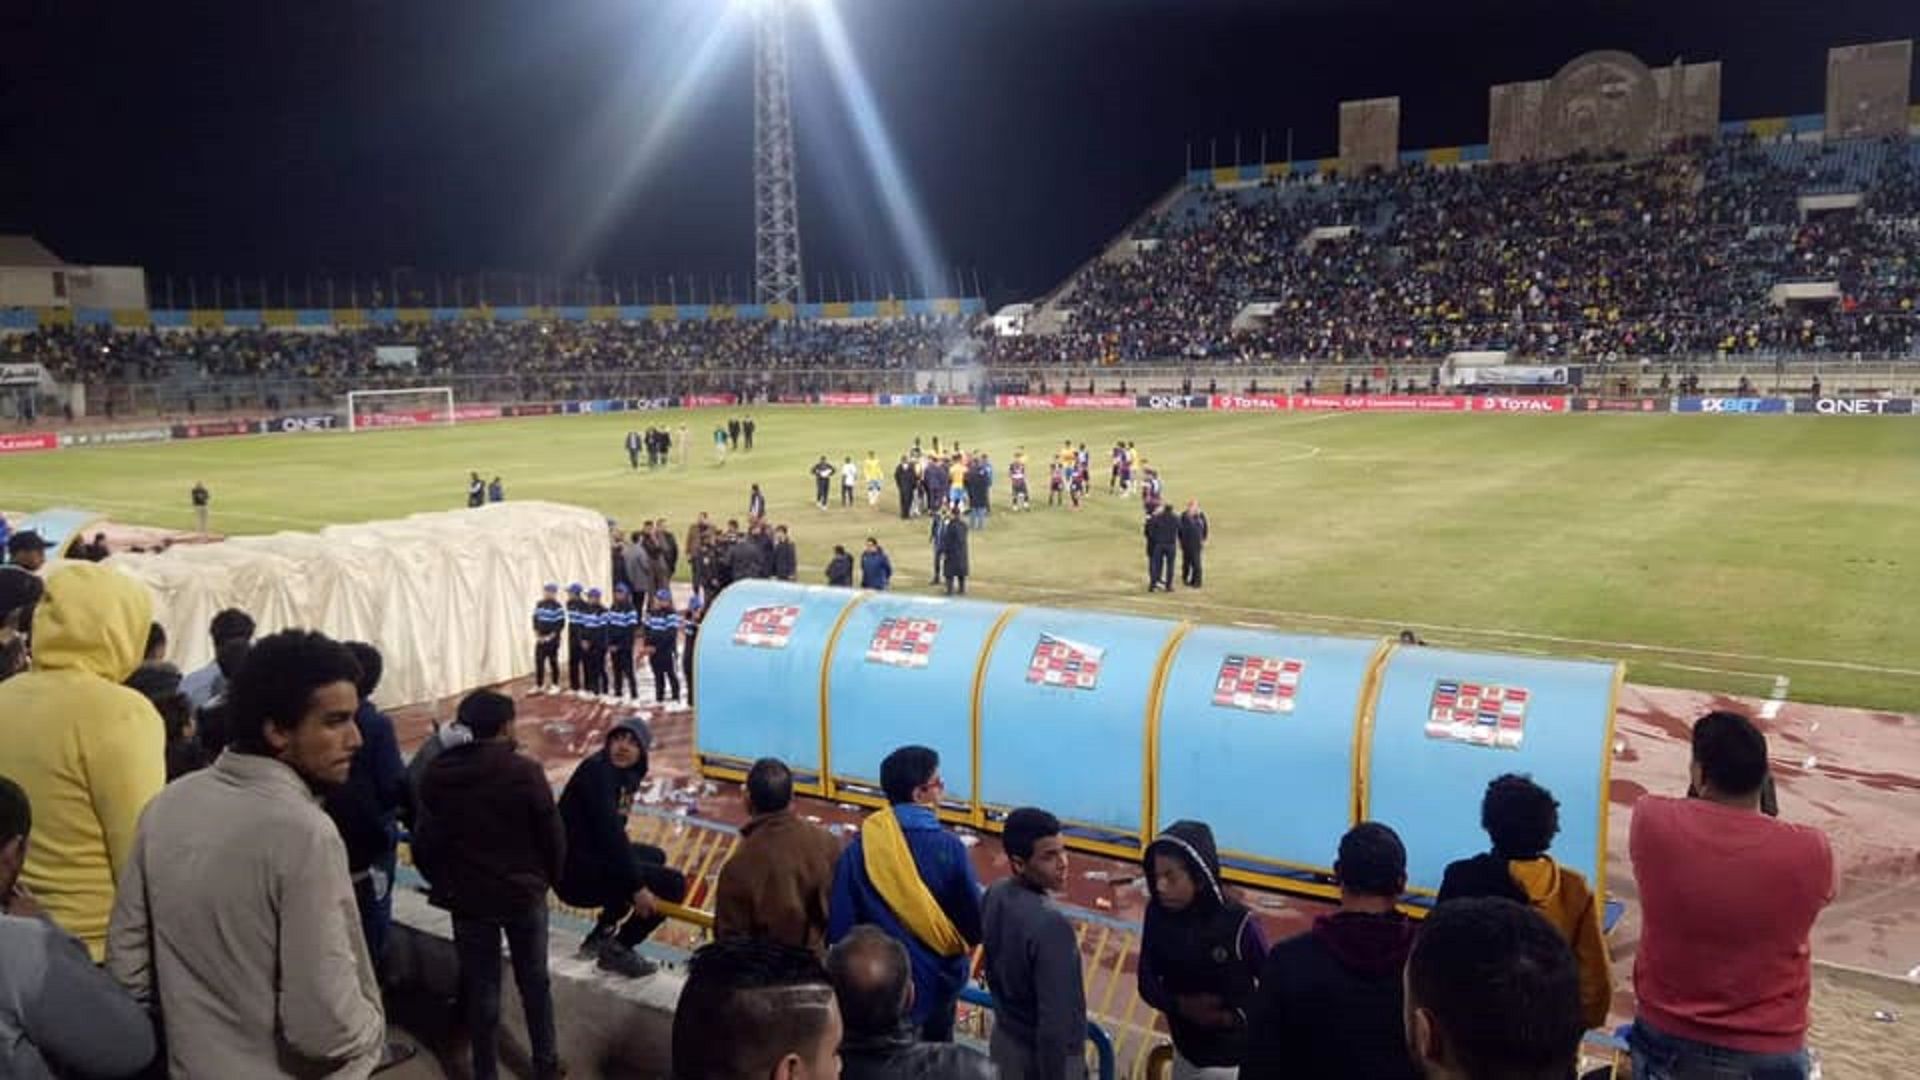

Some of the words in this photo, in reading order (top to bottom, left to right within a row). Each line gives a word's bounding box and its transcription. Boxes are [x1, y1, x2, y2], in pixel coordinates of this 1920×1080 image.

[1149, 395, 1194, 409] QNET
[1235, 399, 1280, 409] TOTAL
[1501, 399, 1553, 411] TOTAL
[1702, 399, 1761, 412] 1XBET
[1815, 399, 1890, 413] QNET
[282, 416, 335, 432] QNET
